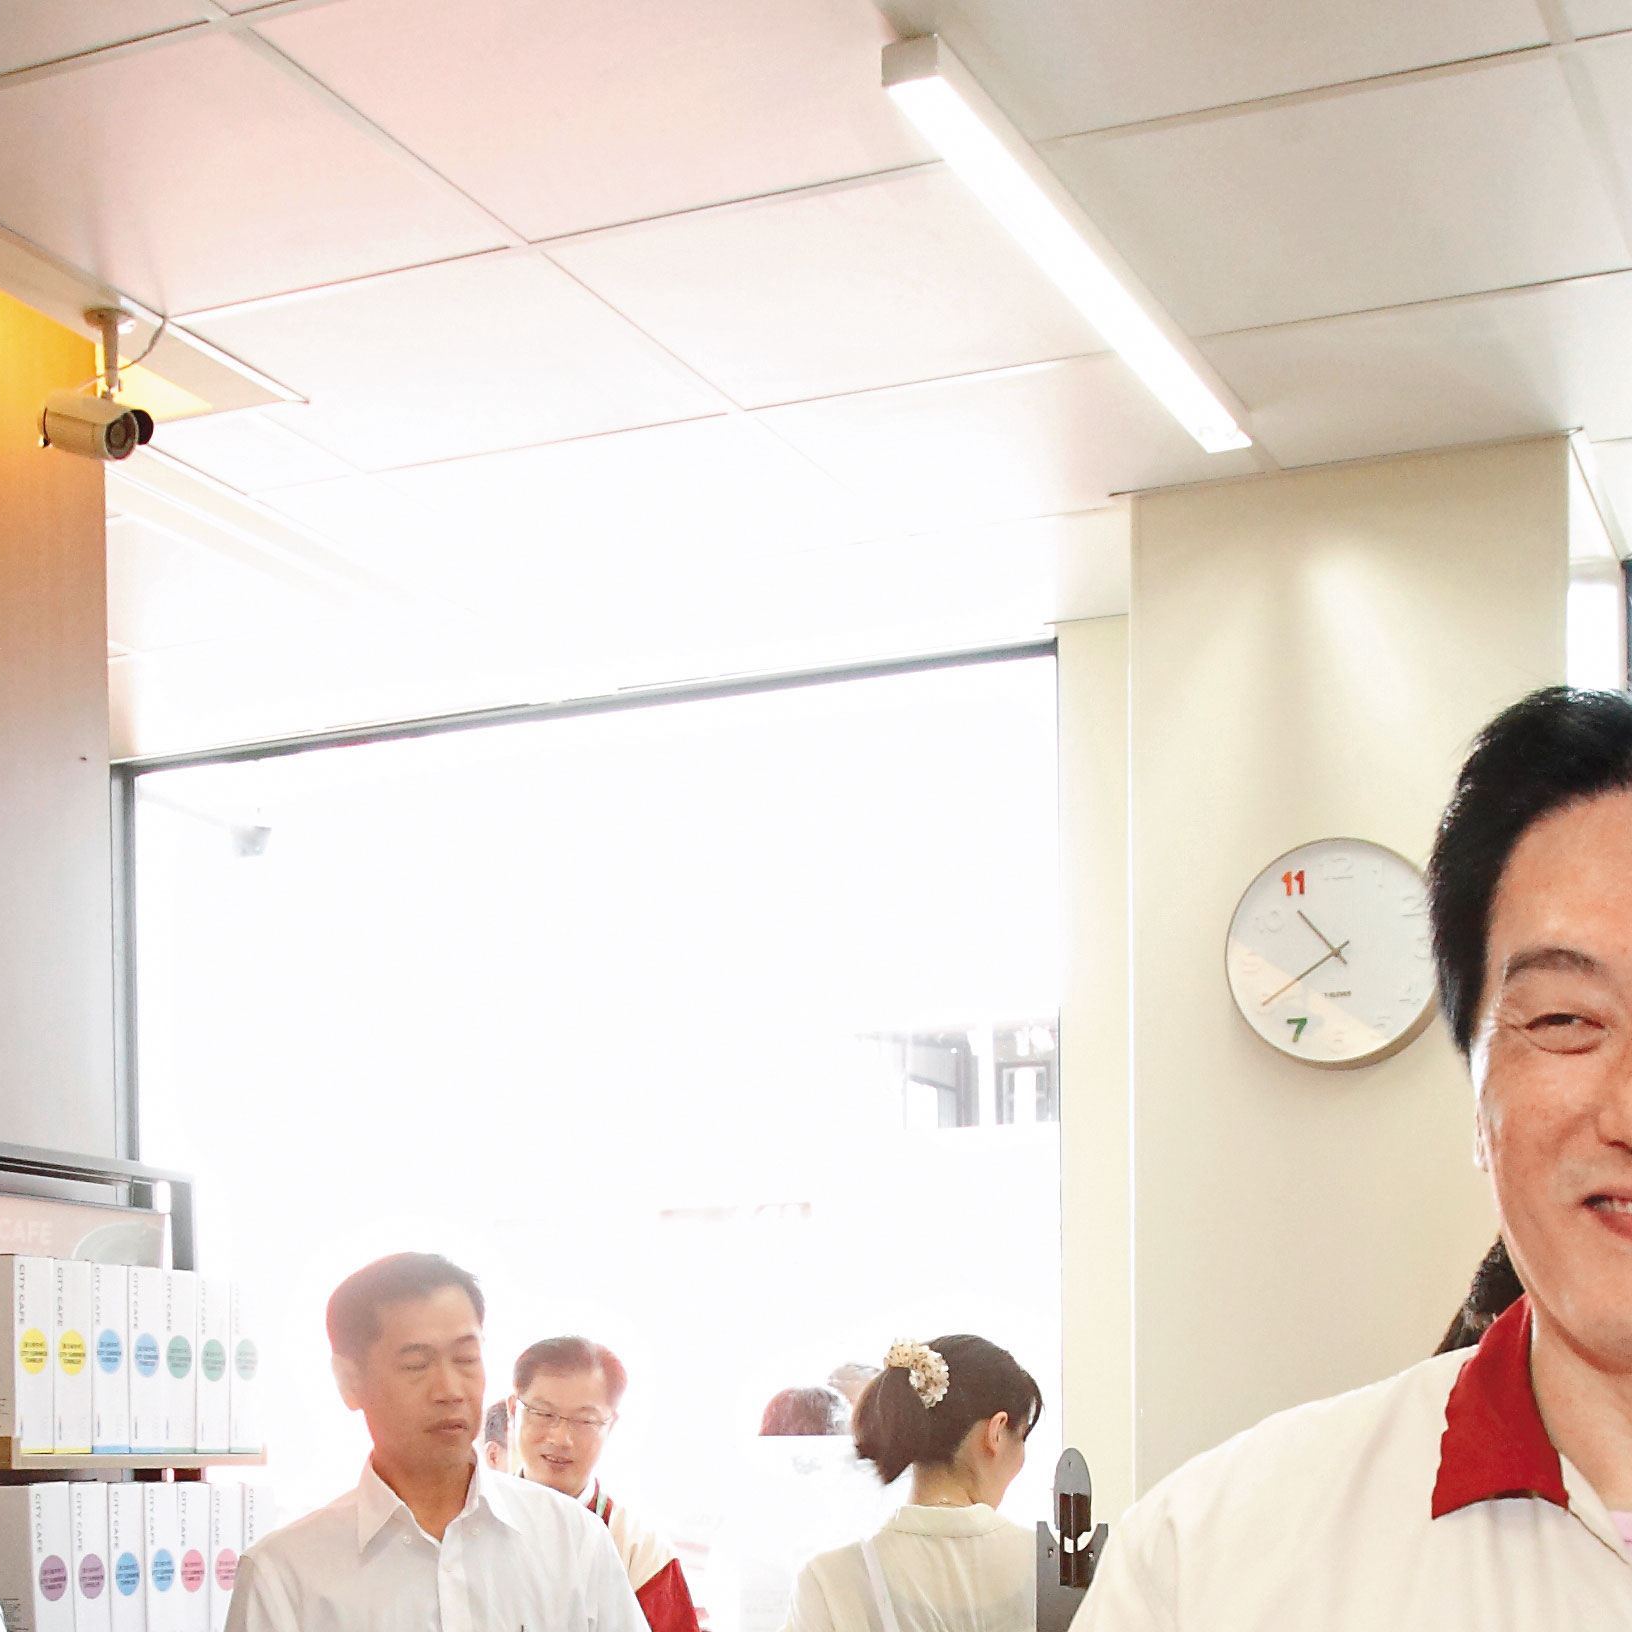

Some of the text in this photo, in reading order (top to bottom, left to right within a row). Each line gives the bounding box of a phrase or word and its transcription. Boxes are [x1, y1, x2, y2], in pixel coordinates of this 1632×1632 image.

[1281, 869, 1306, 897] 11
[1285, 1016, 1309, 1044] 7
[17, 1263, 25, 1326] CITY CAFE
[56, 1266, 64, 1328] CITY CAFE
